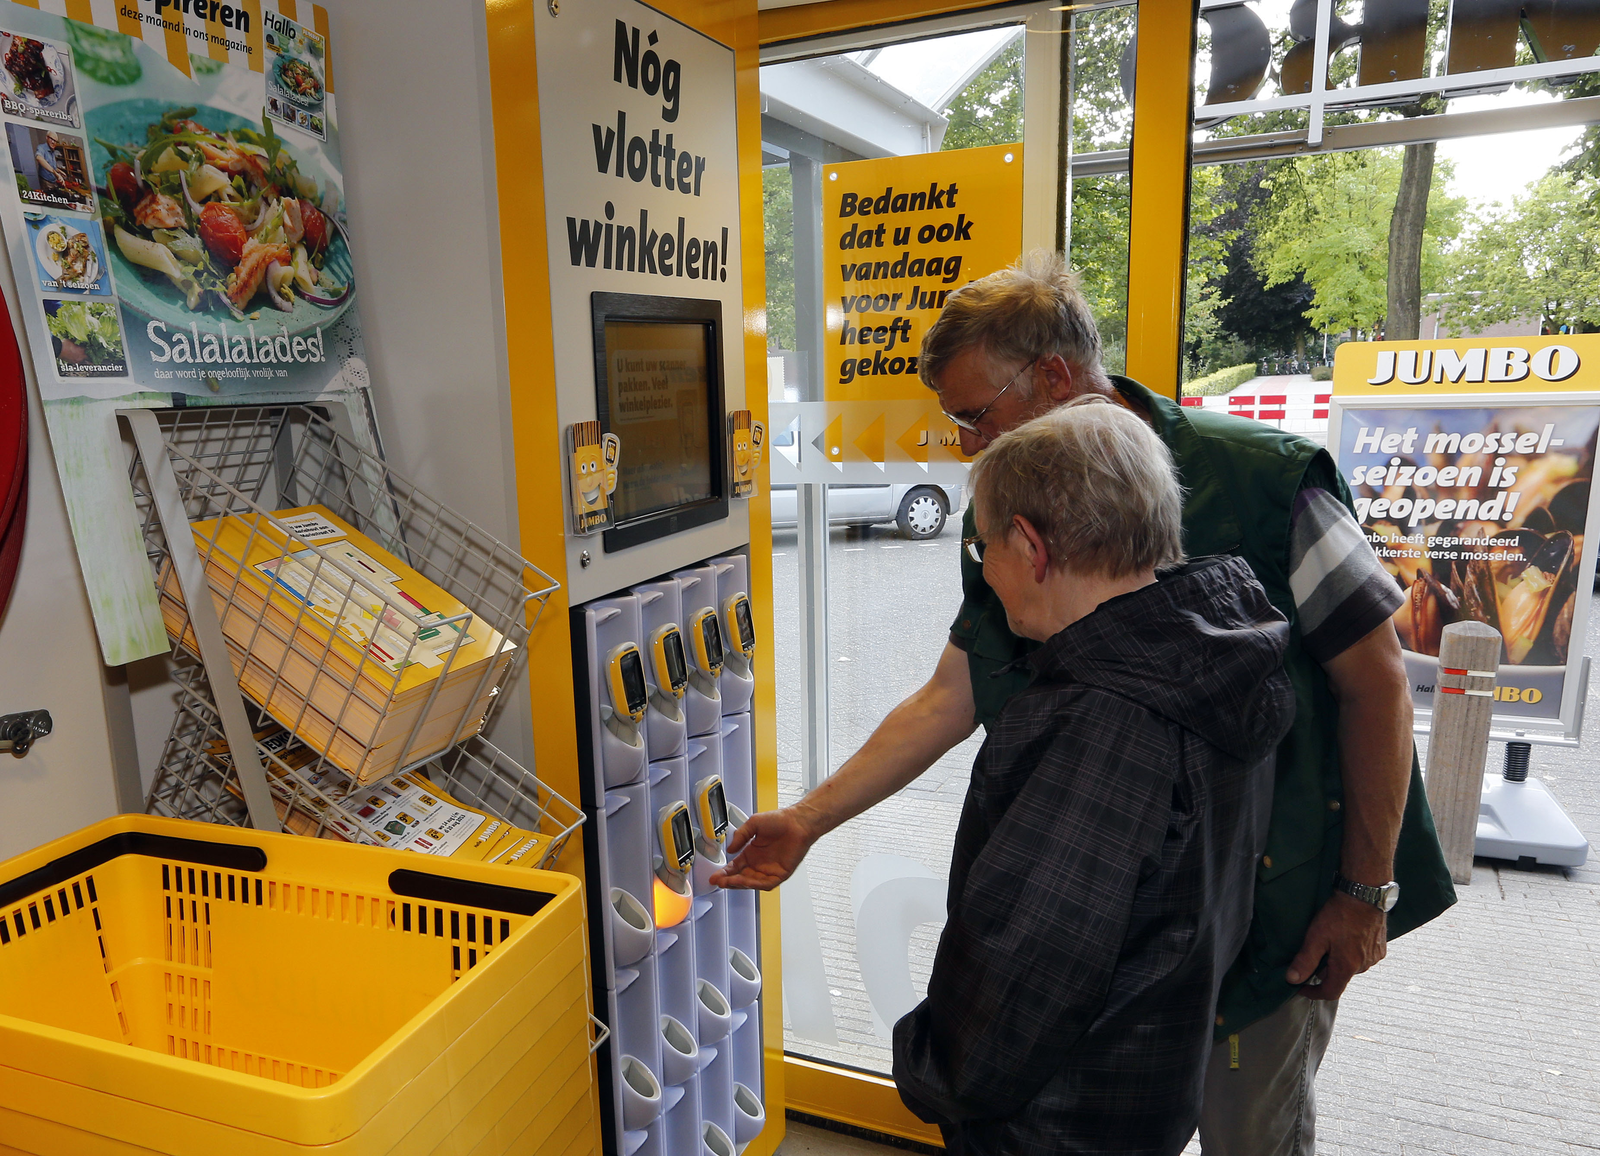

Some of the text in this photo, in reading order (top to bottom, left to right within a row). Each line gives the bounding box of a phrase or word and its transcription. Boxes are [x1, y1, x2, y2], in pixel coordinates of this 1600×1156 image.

[120, 5, 144, 21] deze
[146, 14, 180, 32] maand
[182, 23, 191, 36] in
[193, 29, 209, 42] ons
[211, 34, 252, 54] magazine
[264, 10, 296, 40] Hallo
[613, 18, 681, 123] Nóg
[4, 100, 73, 122] BBQ-spareribs
[592, 110, 706, 197] vlotter
[22, 190, 69, 204] 24Kitchen
[838, 182, 958, 218] Bedankt
[566, 200, 729, 283] winkelen!
[839, 213, 974, 250] dat u ook
[840, 251, 963, 284] vandaag
[42, 280, 58, 288] van
[67, 280, 100, 290] seizoen
[841, 292, 903, 313] voor
[147, 320, 326, 364] Salalalades!
[840, 317, 912, 352] heeft
[60, 363, 123, 372] sla-leverancier
[154, 368, 174, 379] daar
[176, 368, 196, 379] word
[198, 368, 206, 381] je
[252, 368, 274, 380] vrolijk
[276, 370, 288, 378] van
[616, 358, 624, 373] U
[625, 358, 644, 372] kunt
[646, 360, 658, 372] uw
[839, 350, 918, 384] gekoz
[1366, 344, 1581, 385] JUMBO
[618, 377, 650, 398] pakken.
[652, 375, 668, 390] Veel
[619, 394, 673, 414] winkelplezier.
[1353, 423, 1565, 454] Het mossel-
[1350, 457, 1519, 488] seizoen is
[1353, 491, 1521, 528] geopend!
[1375, 547, 1527, 562] kkerste verse mosselen.
[1391, 532, 1425, 544] heeft
[1427, 536, 1519, 548] gegarandeerd
[478, 820, 502, 842] JUMBO
[510, 838, 539, 860] JUMBO
